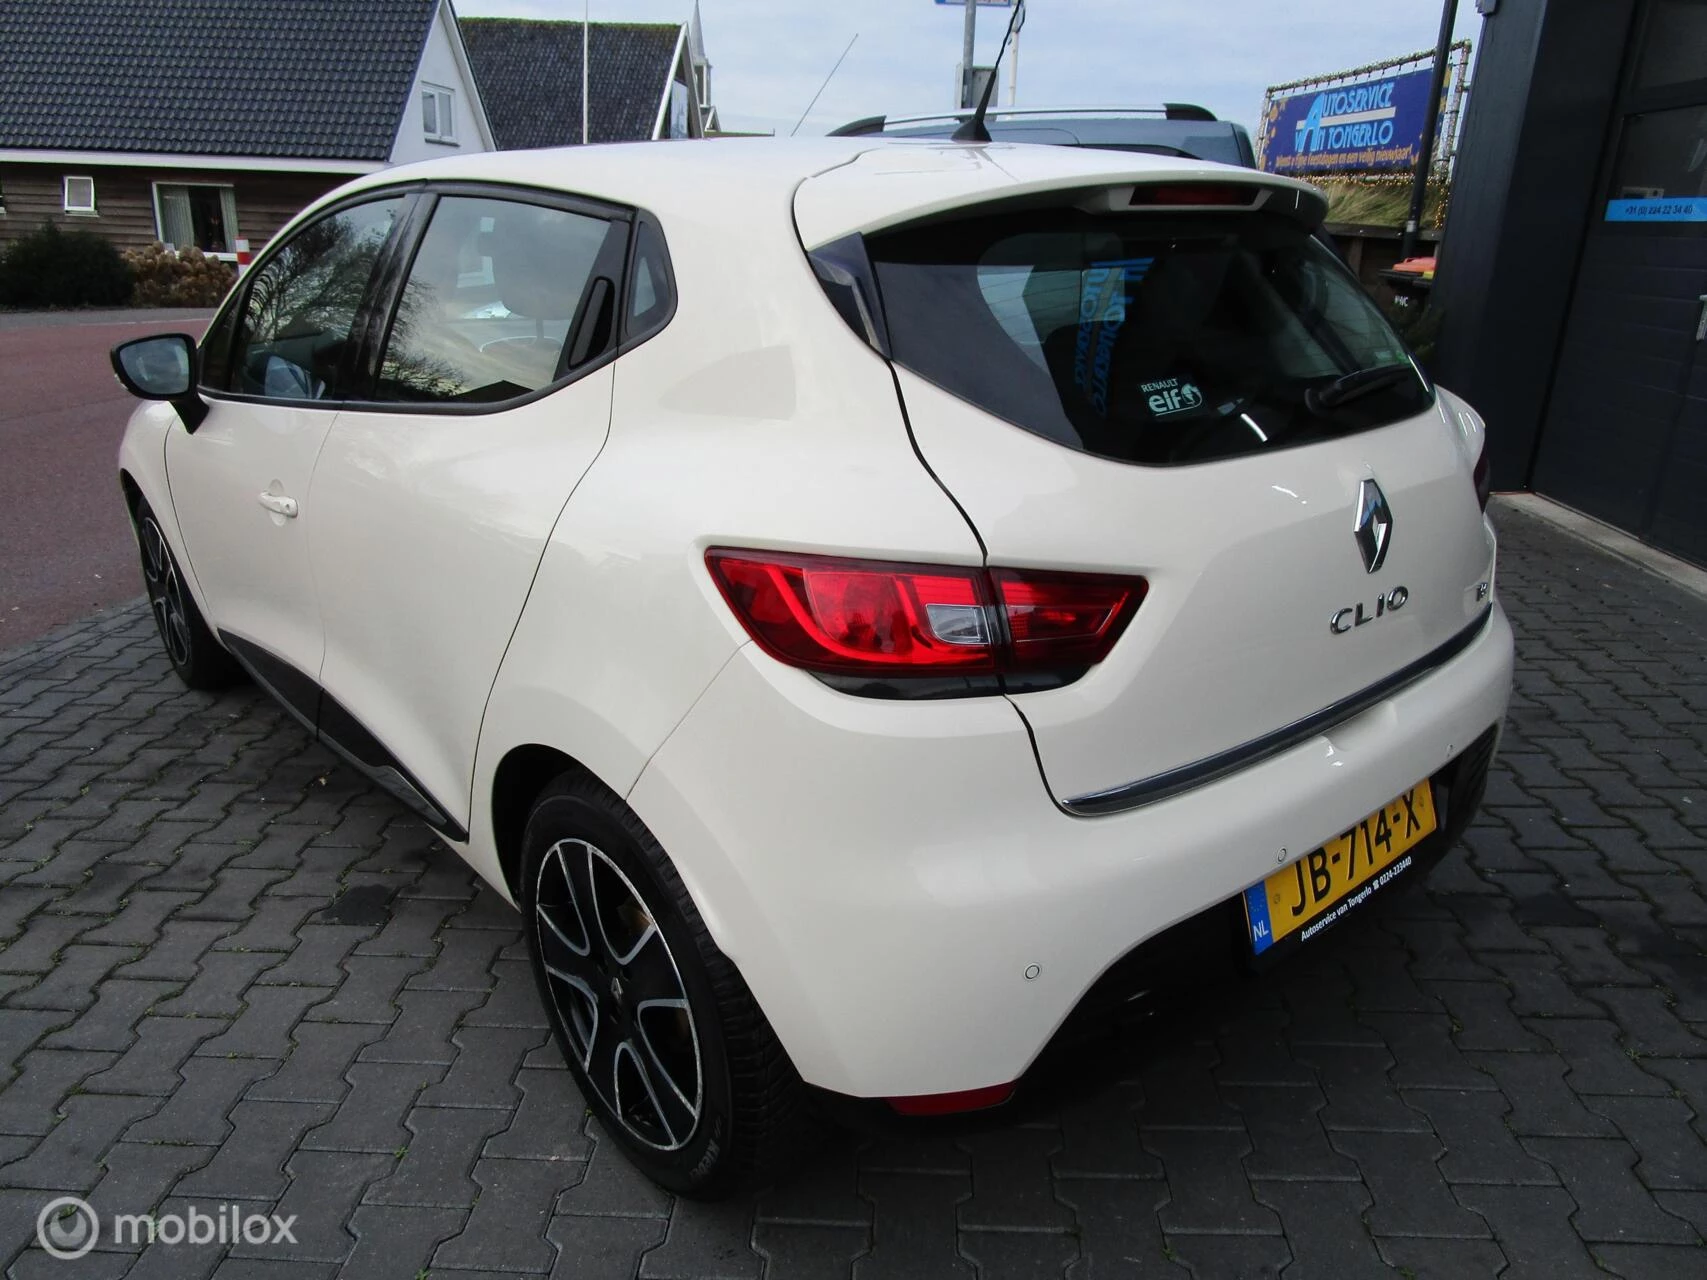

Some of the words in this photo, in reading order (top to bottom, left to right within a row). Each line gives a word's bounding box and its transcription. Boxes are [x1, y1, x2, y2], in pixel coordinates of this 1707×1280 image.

[1328, 121, 1394, 150] TONGERLO
[1141, 378, 1178, 393] RENAULT
[1149, 388, 1182, 413] elf
[1330, 586, 1409, 635] CLIO
[1291, 789, 1421, 917] JB-714-X
[1301, 911, 1337, 942] Autoservice
[1336, 904, 1349, 916] van
[1347, 886, 1372, 908] Tongerlo
[1252, 920, 1269, 941] NL
